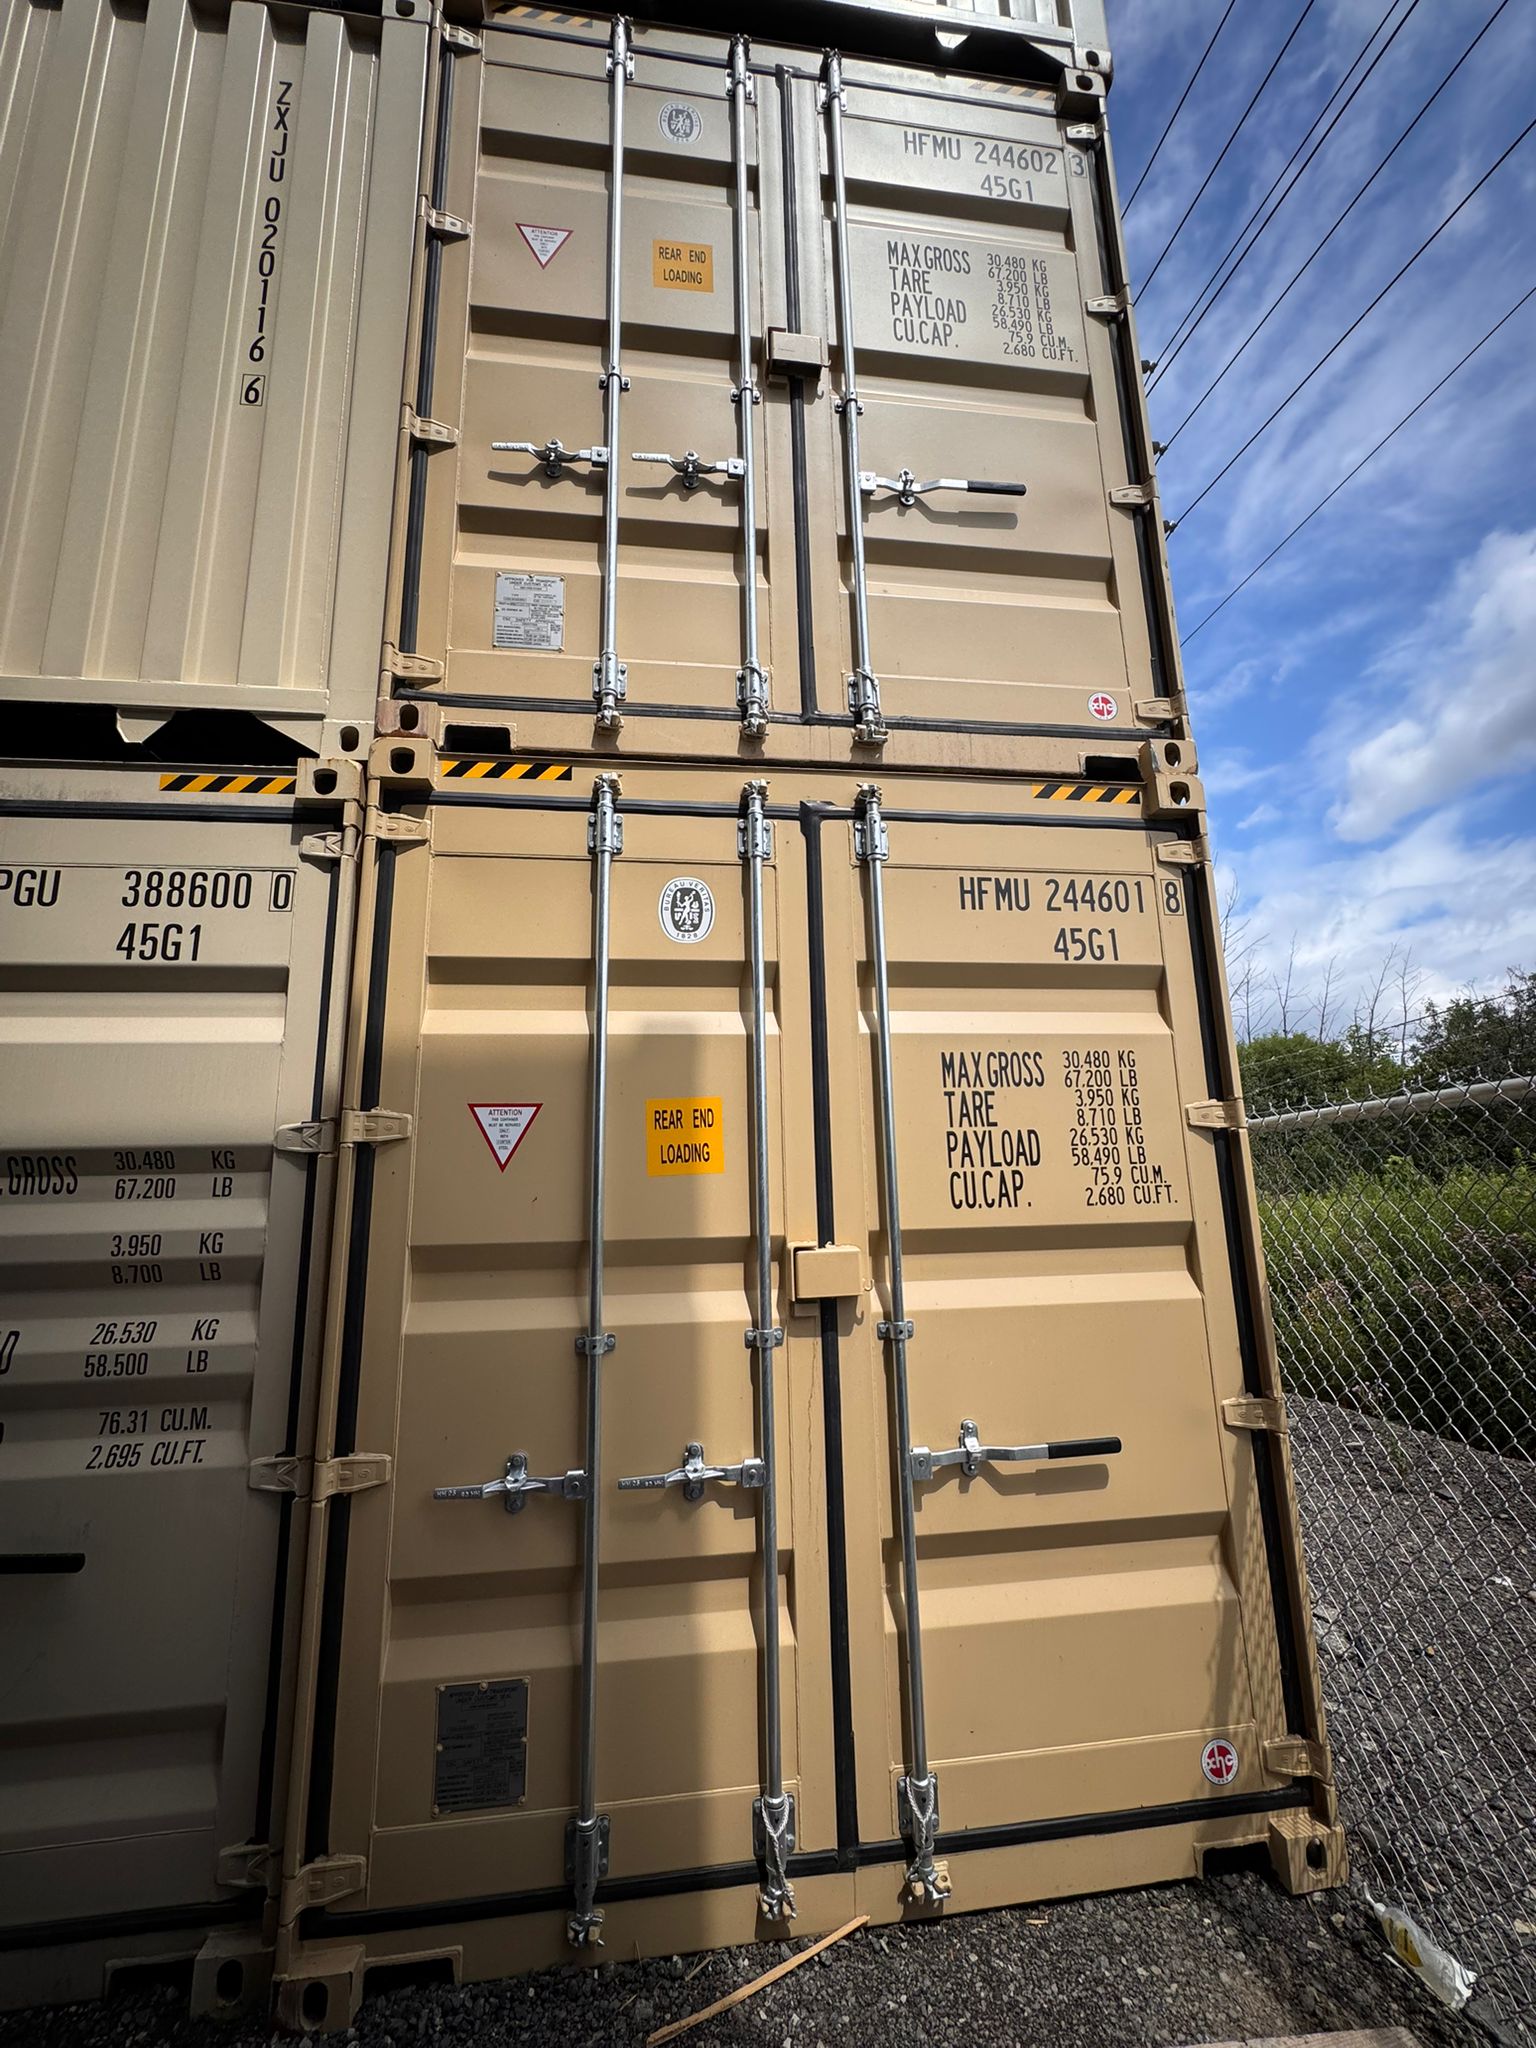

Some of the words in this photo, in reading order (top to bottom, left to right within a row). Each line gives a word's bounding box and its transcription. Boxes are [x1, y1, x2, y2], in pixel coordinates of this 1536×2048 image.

[269, 81, 293, 182] ZXJU
[904, 131, 962, 160] HFMU
[974, 142, 1058, 175] 244602
[1072, 154, 1085, 176] 3
[980, 175, 1034, 202] 45G1
[658, 246, 682, 261] REAR
[689, 250, 706, 264] END
[1032, 258, 1046, 273] KG
[249, 197, 281, 362] 020116
[663, 268, 703, 284] LOADING
[888, 266, 933, 295] TARE
[1034, 285, 1050, 298] KG
[1033, 272, 1048, 286] LB
[890, 292, 967, 324] PAYLOAD
[1037, 310, 1052, 323] KG
[1036, 298, 1051, 310] LB
[1008, 330, 1034, 344] 75.9
[1040, 334, 1070, 350] CU.M.
[1038, 322, 1054, 335] LB
[243, 376, 262, 404] 6
[121, 870, 252, 909] 388600
[272, 873, 292, 910] 0
[664, 882, 685, 912] BUREAU
[688, 881, 710, 912] VERITAS
[958, 876, 1030, 912] HFMU
[1045, 878, 1145, 914] 244601
[1164, 882, 1181, 914] 8
[116, 922, 202, 962] 45G1
[1054, 928, 1120, 962] 45G1
[1062, 1050, 1110, 1069] 30,480
[1118, 1050, 1136, 1068] KG
[1064, 1070, 1112, 1088] 67,200
[1119, 1070, 1138, 1088] LB
[654, 1109, 684, 1130] REAR
[692, 1108, 714, 1128] END
[943, 1090, 998, 1128] TARE
[1074, 1088, 1114, 1108] 3,950
[1121, 1088, 1140, 1106] KG
[1077, 1108, 1116, 1126] 8,710
[1123, 1107, 1142, 1126] LB
[660, 1142, 710, 1164] LOADING
[946, 1129, 1041, 1168] PAYLOAD
[1070, 1127, 1118, 1146] 26,530
[1125, 1126, 1144, 1145] KG
[1071, 1146, 1120, 1166] 58,490
[1127, 1146, 1147, 1165] LB
[114, 1150, 176, 1170] 30,480
[210, 1150, 236, 1170] KG
[114, 1178, 176, 1200] 67,200
[212, 1176, 233, 1198] LB
[1090, 1166, 1122, 1186] 75.9
[1130, 1165, 1168, 1184] CU.M.
[1084, 1186, 1126, 1206] 2,680
[1133, 1184, 1178, 1204] CU.FT.
[110, 1234, 162, 1257] 3,950
[198, 1232, 224, 1254] KG
[111, 1264, 163, 1284] 8,700
[200, 1262, 222, 1281] LB
[90, 1321, 158, 1345] 26,530
[191, 1318, 220, 1341] KG
[84, 1352, 148, 1378] 58,500
[186, 1350, 208, 1373] LB
[98, 1410, 148, 1435] 76.31
[160, 1406, 212, 1432] CU.M.
[85, 1442, 144, 1470] 2,695
[150, 1440, 206, 1466] CU.FT.
